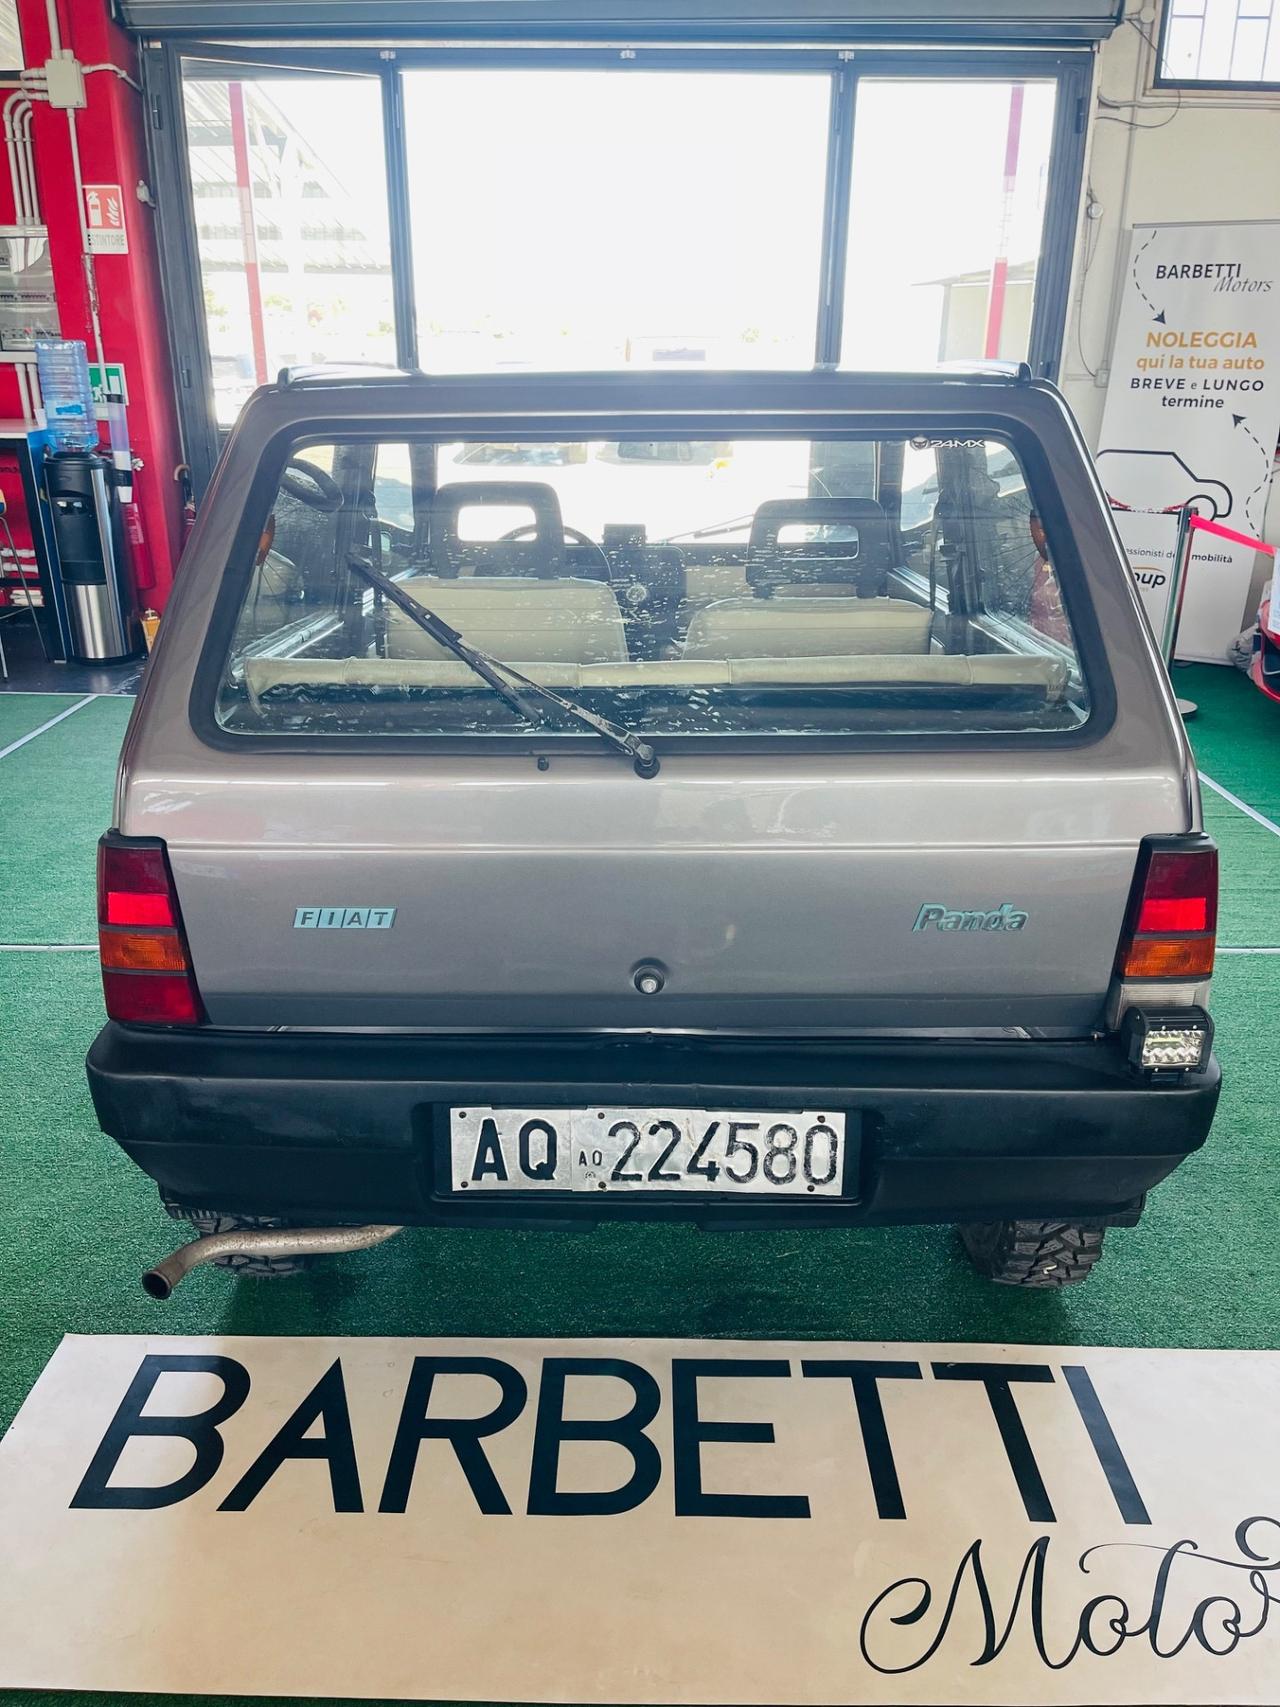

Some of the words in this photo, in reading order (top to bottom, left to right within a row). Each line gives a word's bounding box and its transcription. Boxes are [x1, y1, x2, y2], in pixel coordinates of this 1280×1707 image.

[1155, 263, 1242, 279] BARBETTI
[1213, 276, 1273, 293] Motors
[1145, 331, 1258, 348] NOLEGGIA
[1136, 354, 1165, 371] qui
[1169, 355, 1185, 369] la
[1188, 356, 1219, 370] tua
[1222, 356, 1265, 371] auto
[1130, 377, 1186, 390] BREVE
[1190, 382, 1198, 390] e
[1202, 378, 1265, 392] LUNGO
[1161, 394, 1225, 409] termine
[930, 439, 985, 448] 24MX
[1191, 553, 1233, 564] mobilità
[298, 910, 391, 927] FIAT
[912, 902, 1029, 932] Panda
[470, 1117, 559, 1182] AQ
[607, 1119, 839, 1186] 224580
[68, 1354, 1153, 1525] BARBETTI
